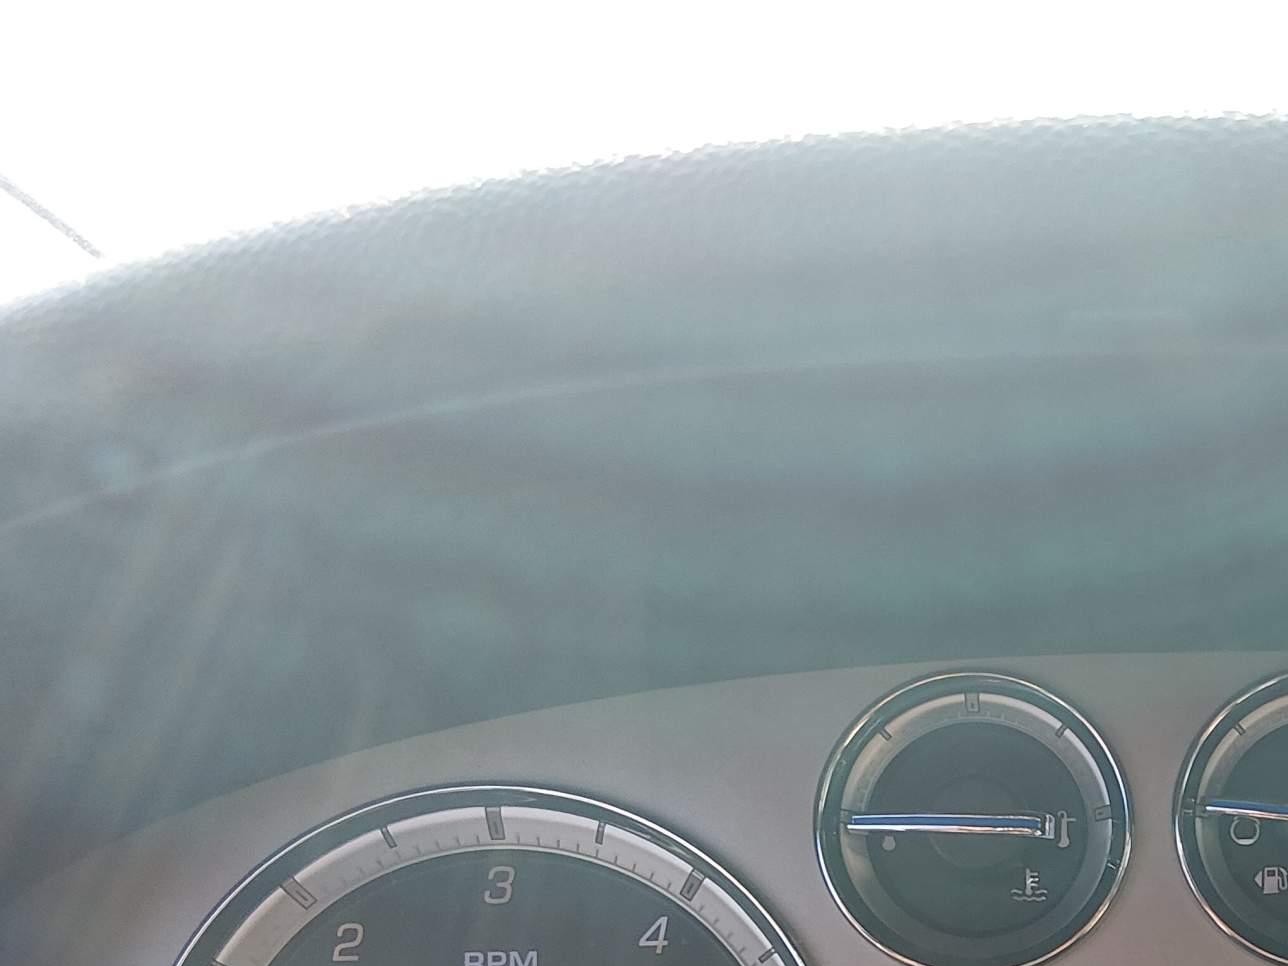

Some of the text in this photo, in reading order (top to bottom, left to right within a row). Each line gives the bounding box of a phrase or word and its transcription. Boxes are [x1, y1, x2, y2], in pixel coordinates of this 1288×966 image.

[485, 866, 514, 904] 3
[333, 924, 363, 962] 2
[639, 916, 668, 954] 4
